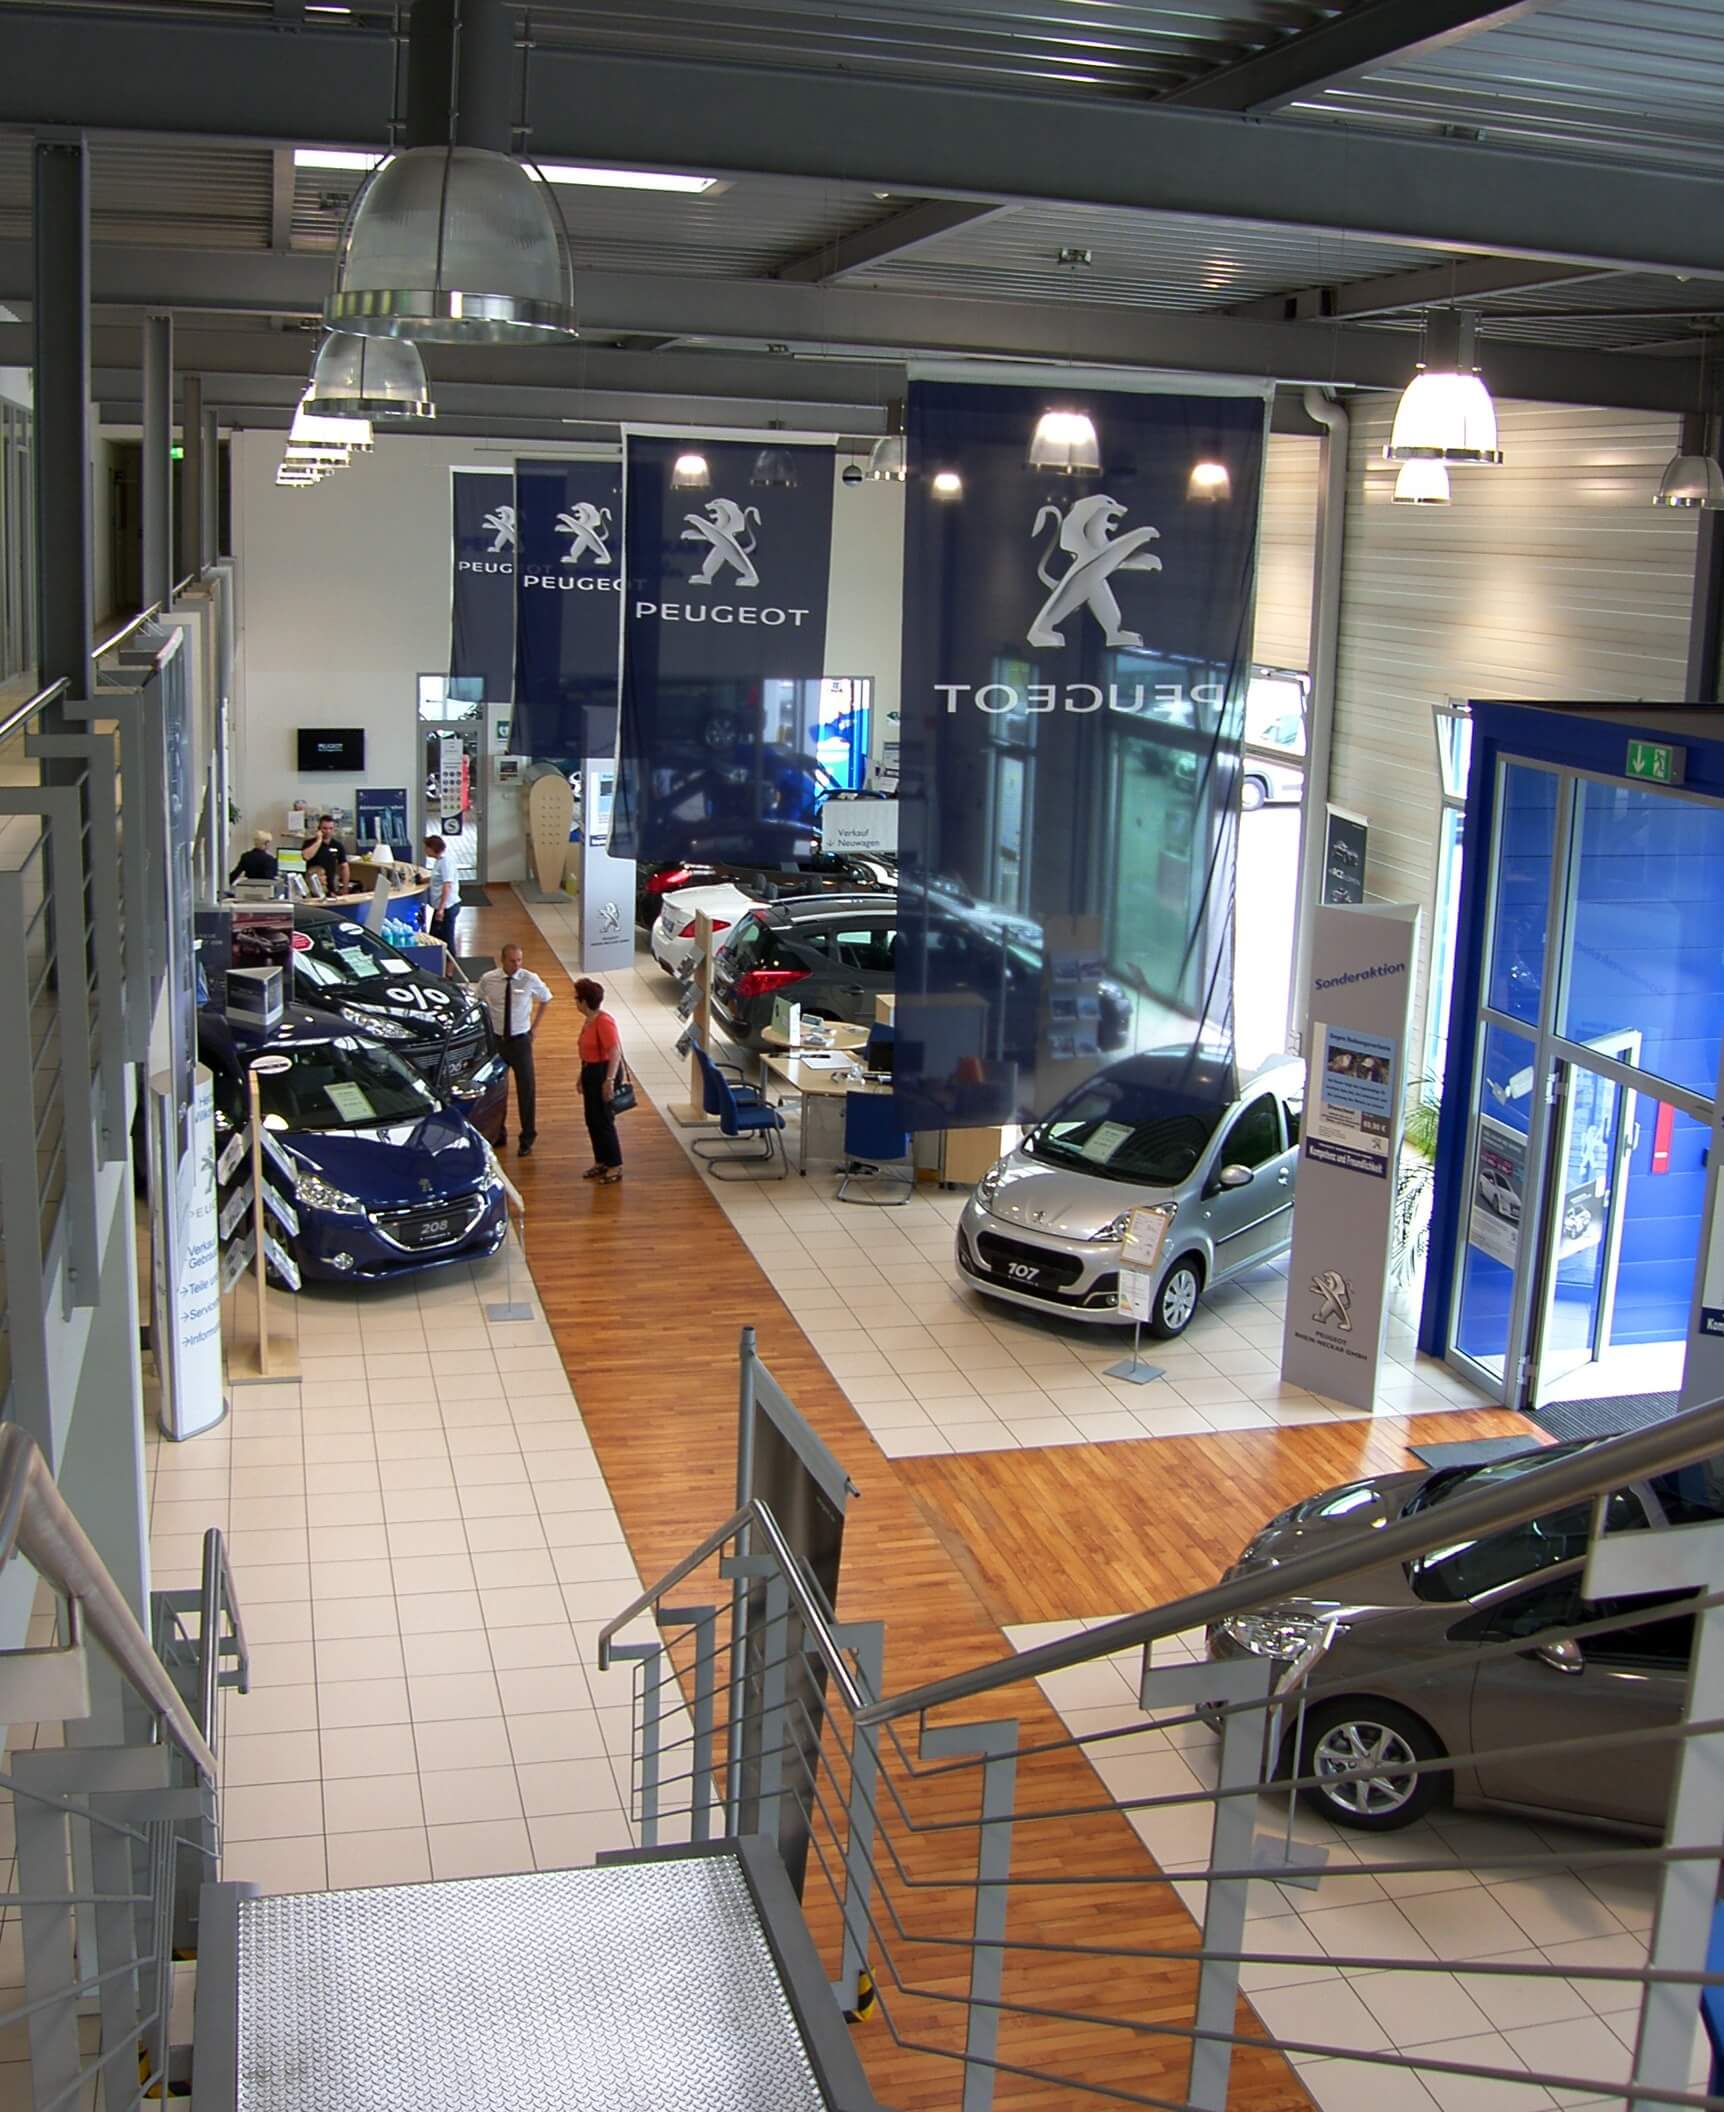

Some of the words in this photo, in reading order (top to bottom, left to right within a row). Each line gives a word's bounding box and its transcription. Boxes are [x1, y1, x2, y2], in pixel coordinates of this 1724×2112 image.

[458, 560, 513, 575] PEUG
[635, 601, 810, 627] PEUGEOT
[838, 828, 870, 837] Verkauf
[838, 839, 880, 849] Neuwagen
[1315, 962, 1405, 990] Sonderaktion
[421, 1219, 448, 1234] 208
[1008, 1262, 1040, 1280] 107
